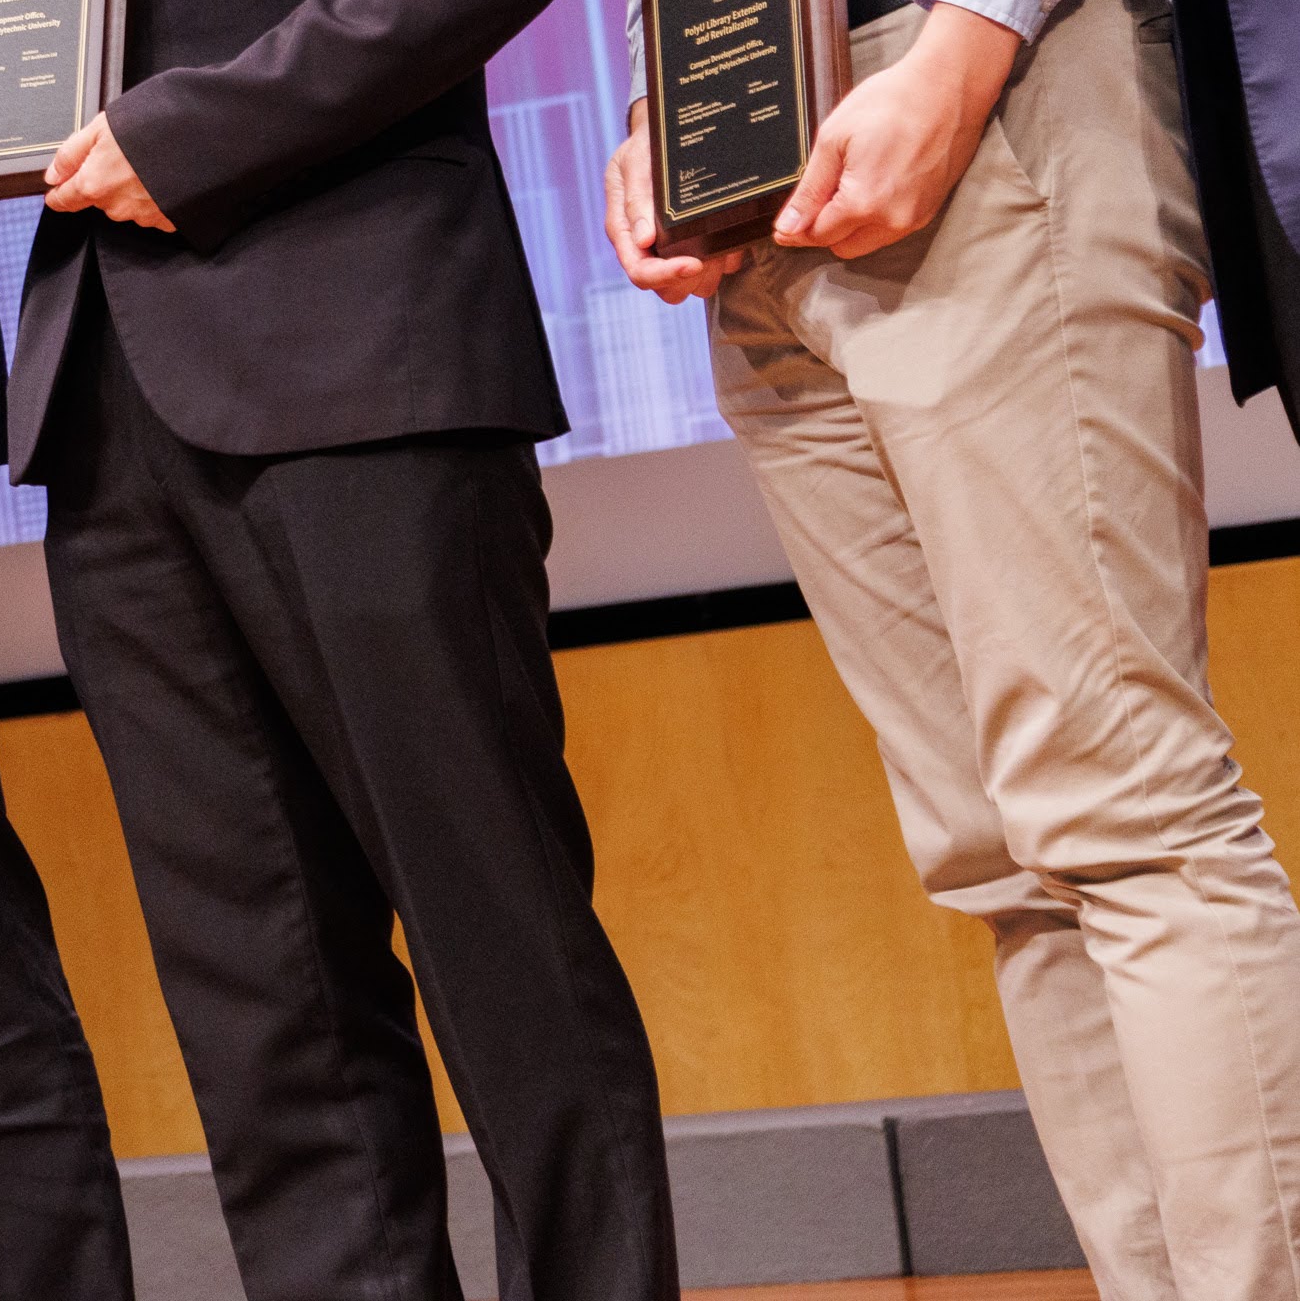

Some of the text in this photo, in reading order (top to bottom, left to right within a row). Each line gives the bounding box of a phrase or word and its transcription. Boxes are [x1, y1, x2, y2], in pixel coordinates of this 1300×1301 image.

[28, 18, 61, 30] University
[684, 0, 767, 39] PolyU Library Extension
[696, 16, 759, 47] and Revitalization
[679, 43, 777, 87] The Hong Kong Polytechnic University
[689, 58, 710, 71] Campus
[711, 43, 746, 63] Development
